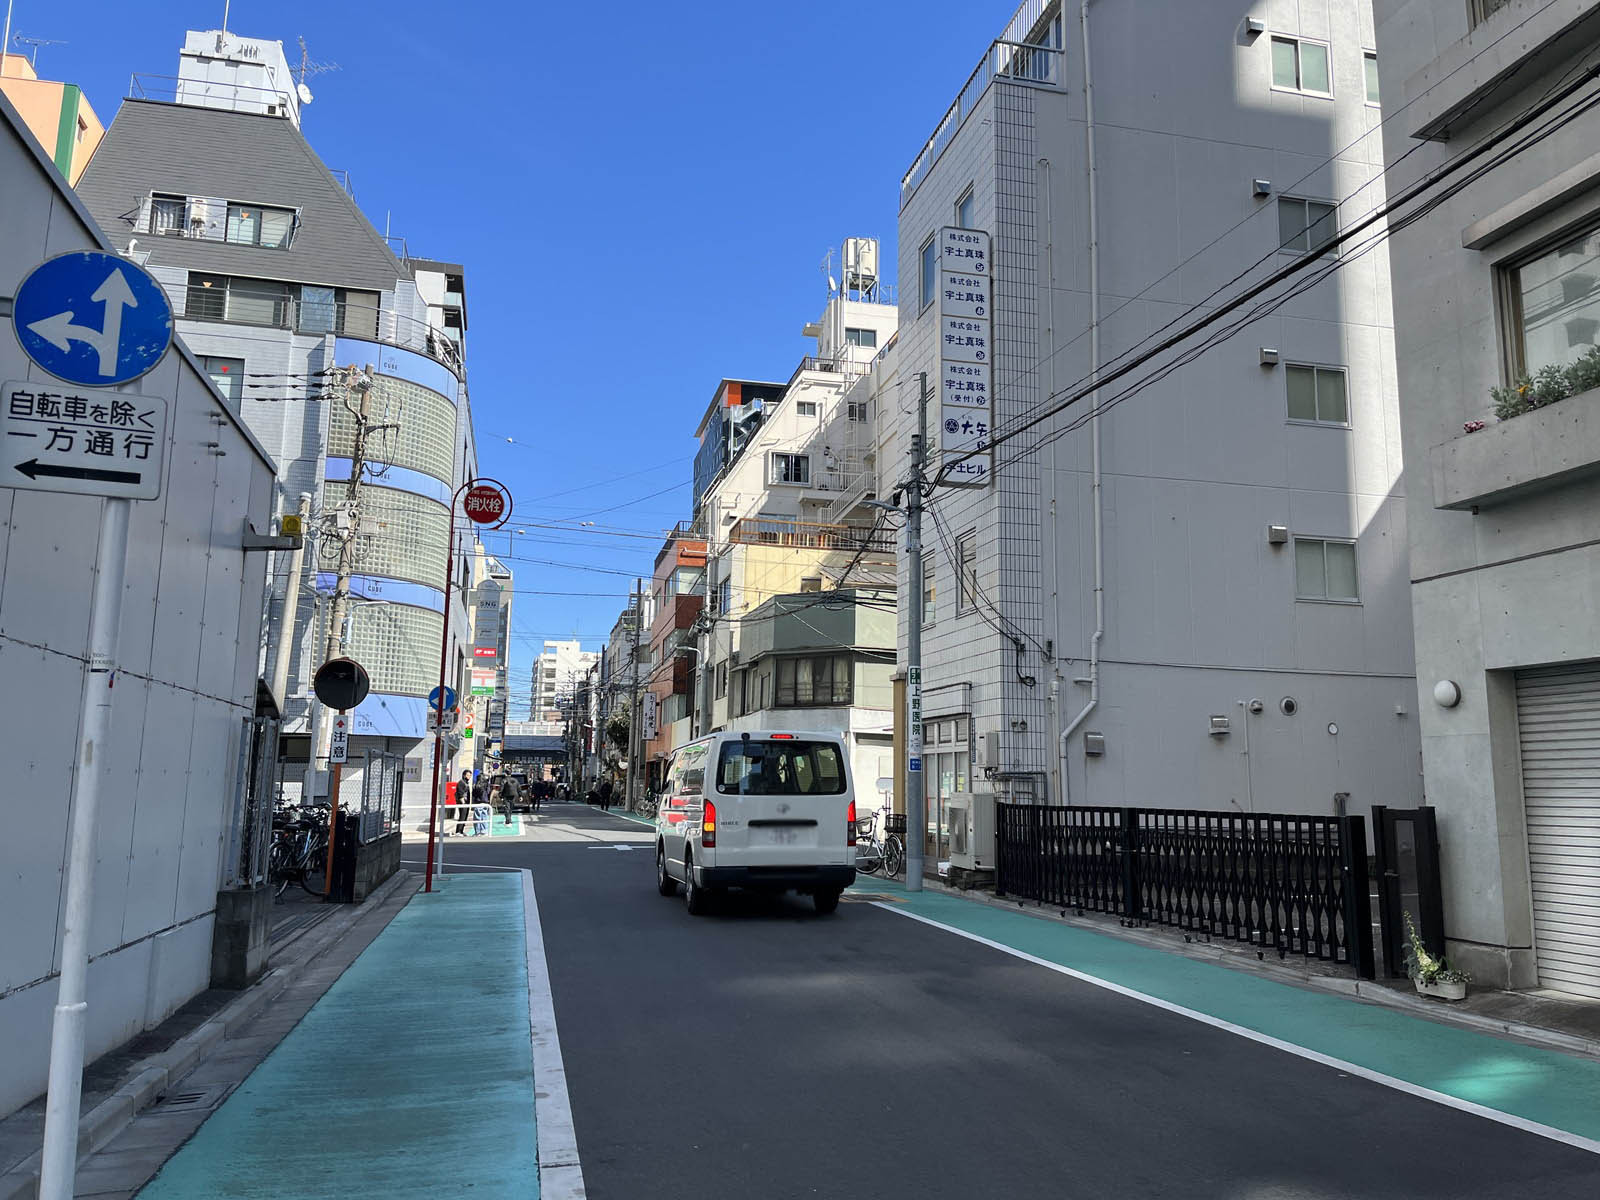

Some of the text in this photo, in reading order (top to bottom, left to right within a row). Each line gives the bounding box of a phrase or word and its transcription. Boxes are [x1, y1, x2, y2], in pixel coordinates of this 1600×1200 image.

[949, 233, 980, 243] 株式会社
[945, 246, 984, 260] 宇土真珠
[950, 277, 980, 287] 株式会社
[945, 290, 985, 304] 宇土真珠
[950, 321, 981, 332] 株式会社
[945, 334, 985, 348] 宇土真珠
[950, 366, 981, 376] 株式会社
[945, 379, 986, 392] 宇土真珠
[9, 390, 156, 428] 自転車を除く
[7, 427, 154, 460] 一方通行
[468, 497, 502, 513] 消火栓
[333, 731, 346, 758] 注意
